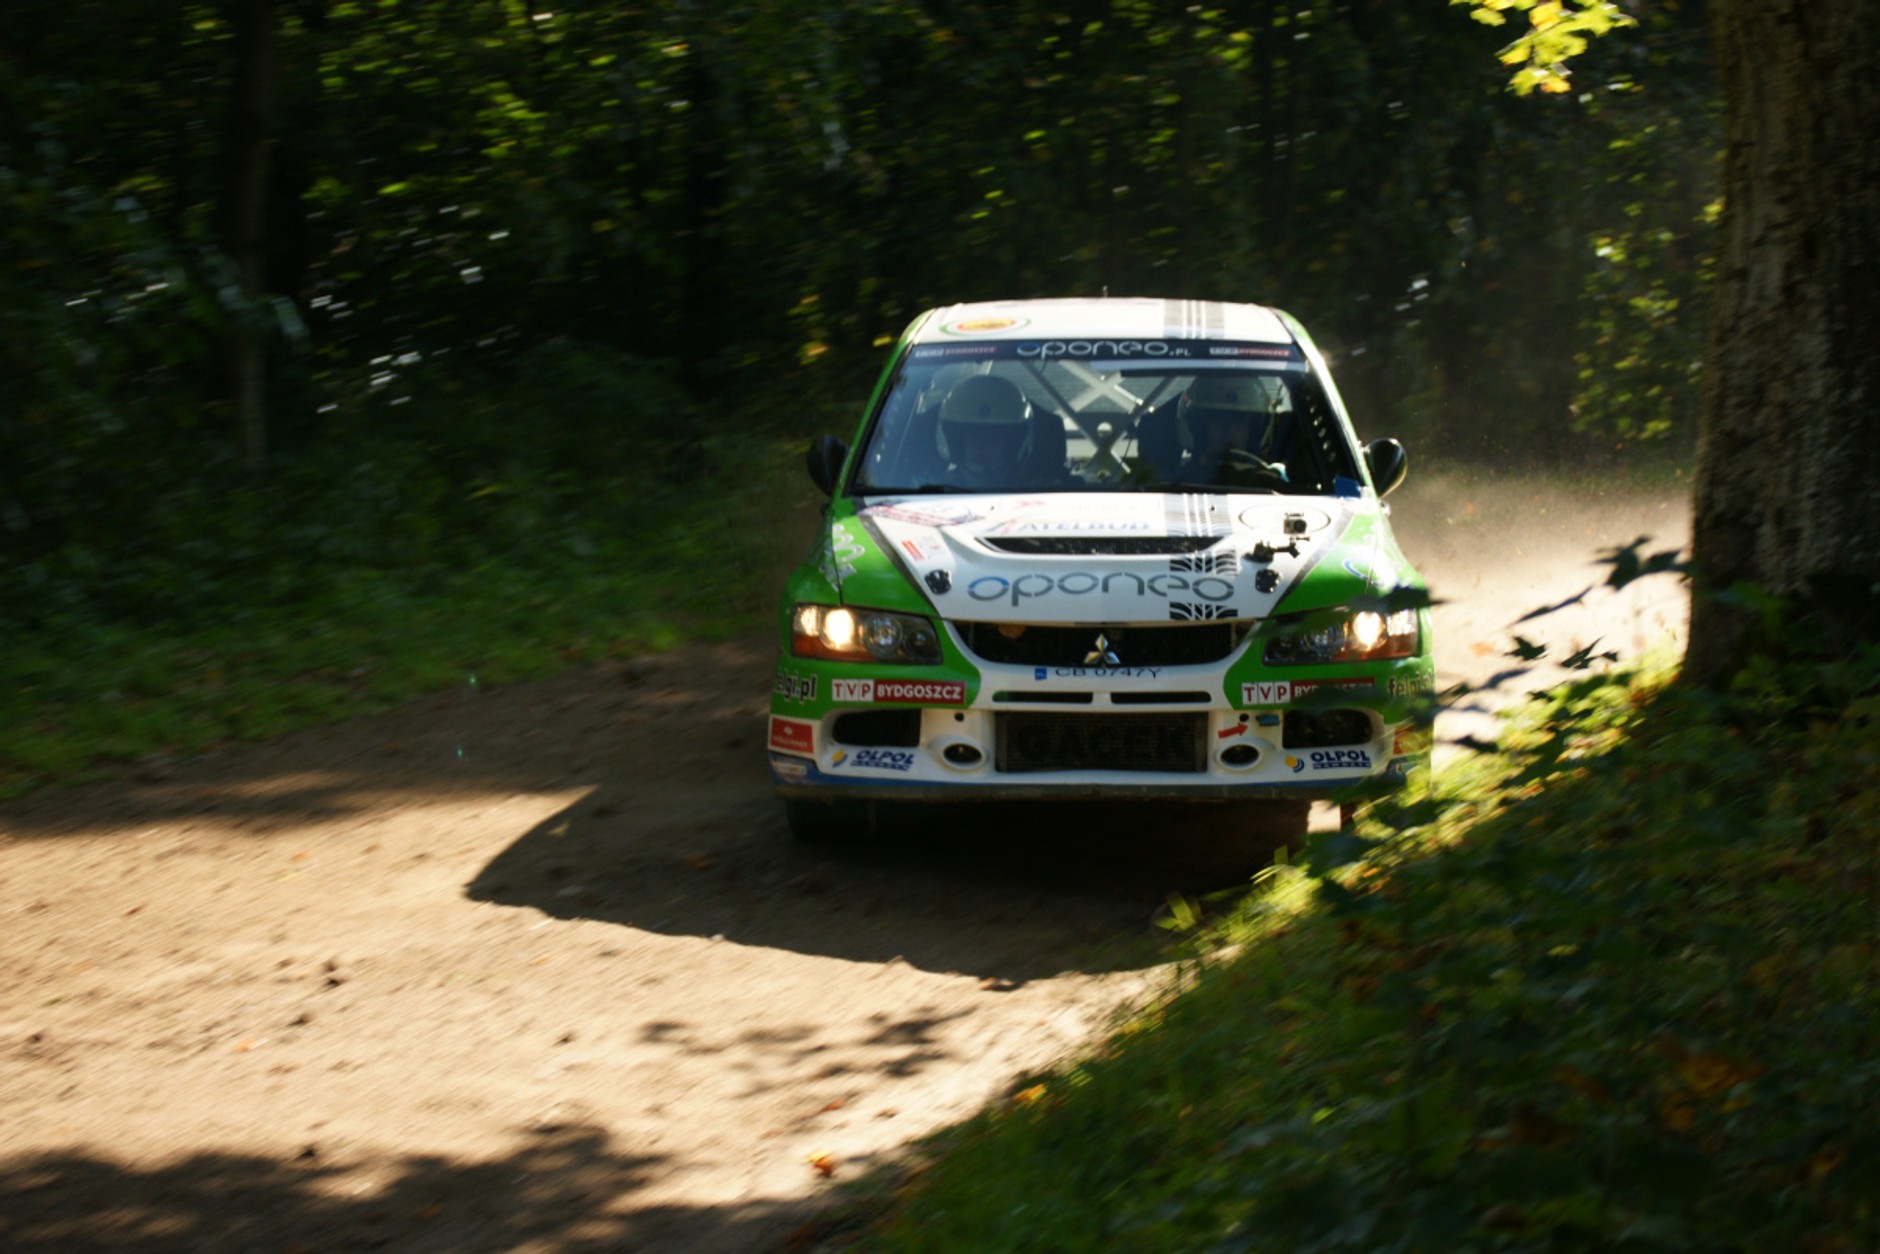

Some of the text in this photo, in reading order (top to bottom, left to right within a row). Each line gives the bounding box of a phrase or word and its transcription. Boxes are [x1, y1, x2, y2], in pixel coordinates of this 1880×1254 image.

[967, 571, 1235, 608] oponeo
[833, 682, 961, 700] TVP BYDGOSZCZ
[1243, 685, 1288, 702] TVP
[855, 749, 915, 765] OLPOL
[1310, 749, 1371, 763] OLPOL
